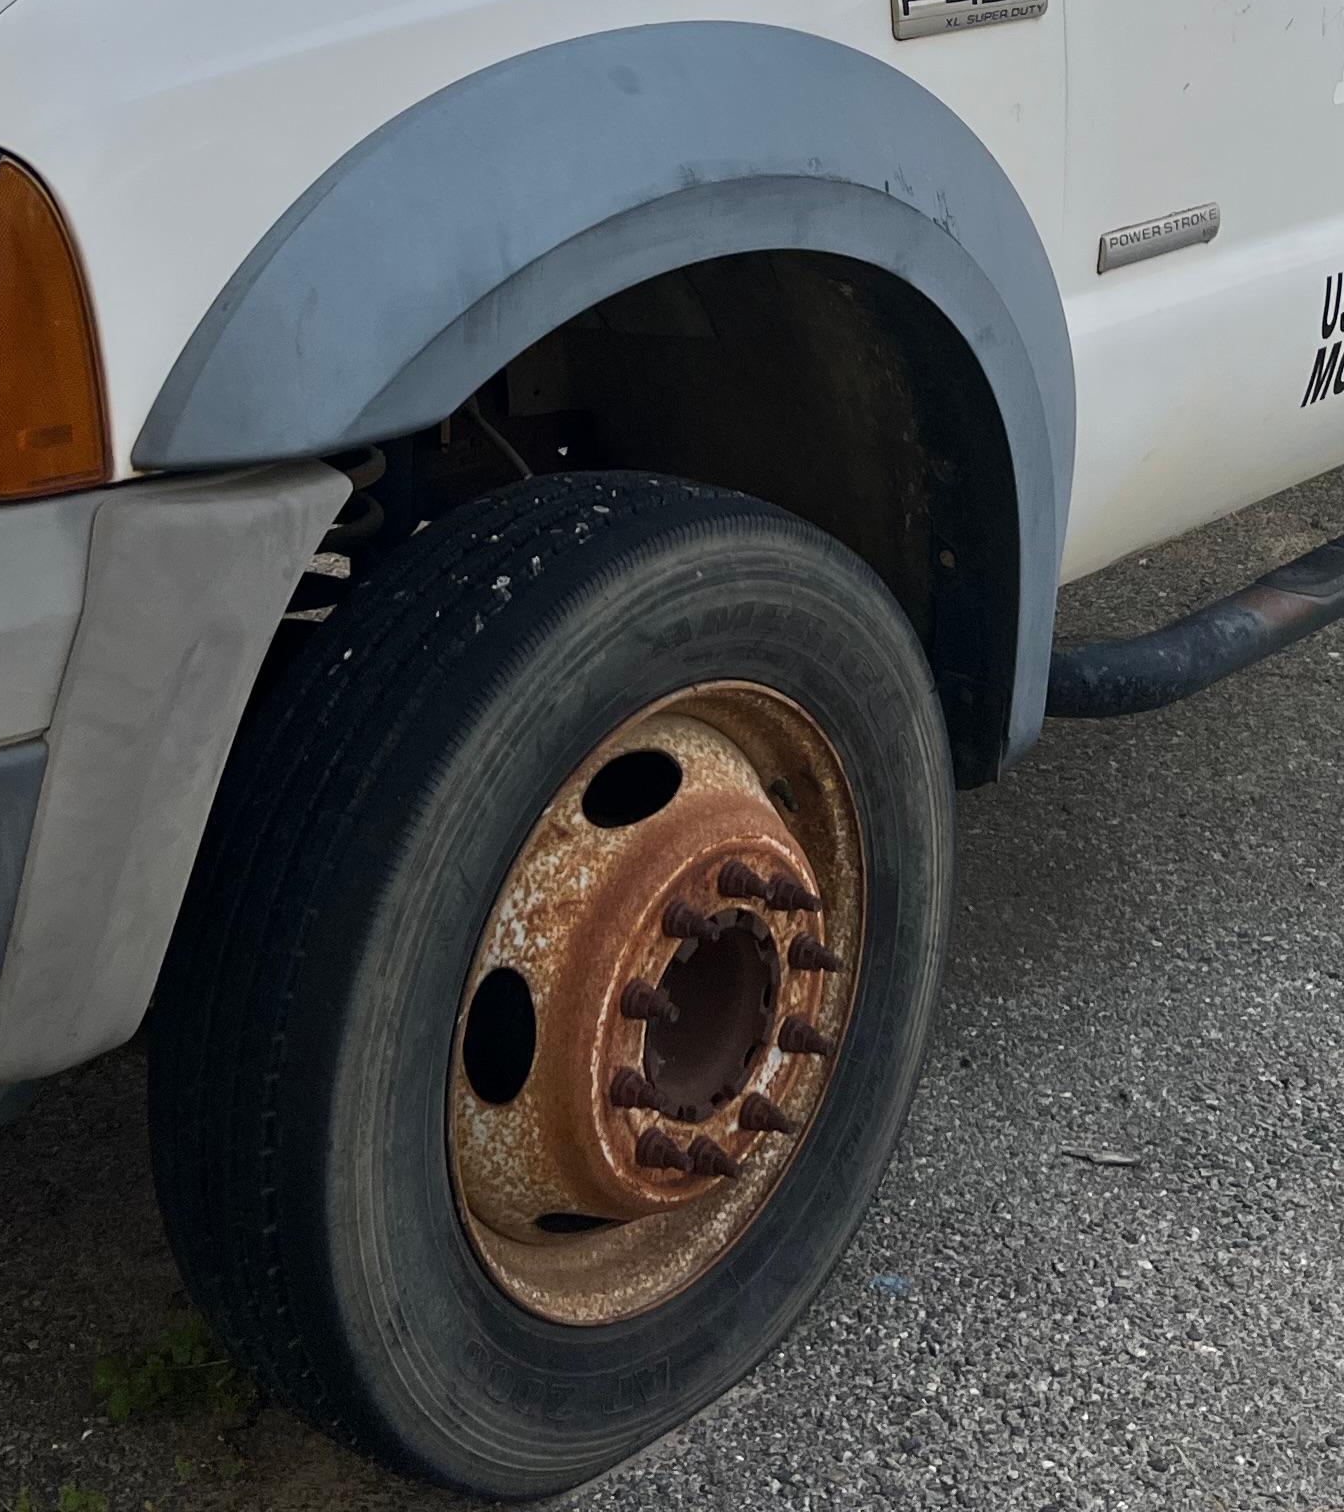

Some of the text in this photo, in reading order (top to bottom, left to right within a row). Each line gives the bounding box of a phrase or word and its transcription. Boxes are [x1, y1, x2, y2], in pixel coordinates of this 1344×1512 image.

[945, 3, 1045, 29] XL SUPER DUTY
[1109, 225, 1162, 249] POWER
[1163, 207, 1217, 234] STROKE
